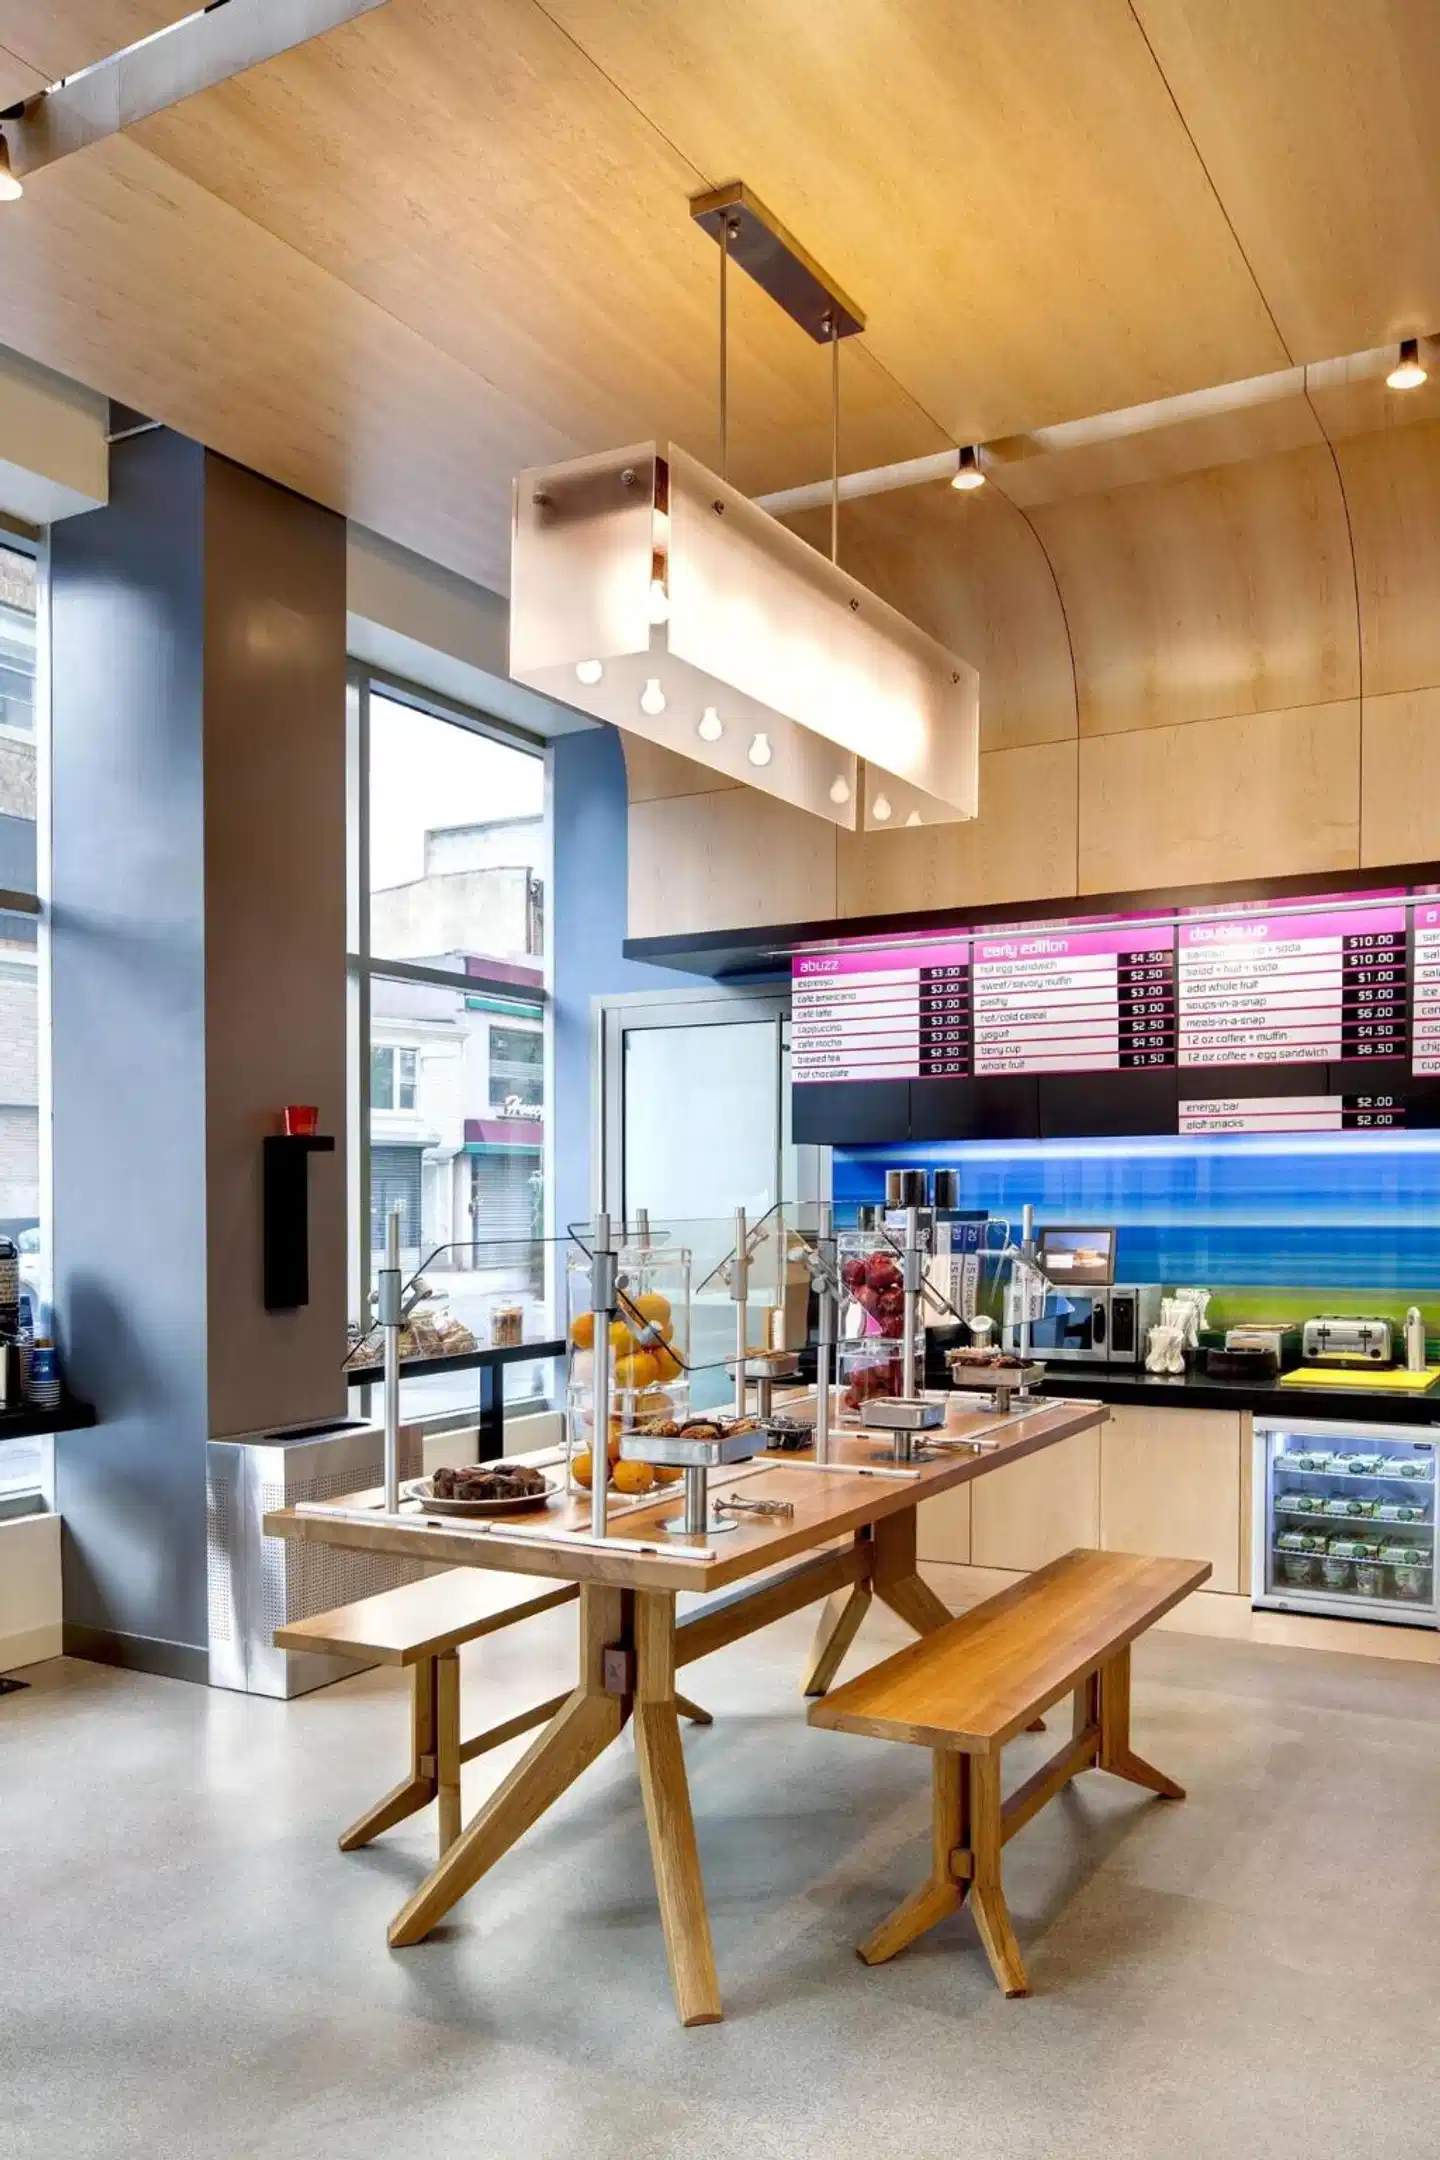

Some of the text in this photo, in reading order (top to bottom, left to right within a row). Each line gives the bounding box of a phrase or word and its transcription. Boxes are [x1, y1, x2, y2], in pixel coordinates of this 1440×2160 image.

[1020, 939, 1068, 954] edition
[800, 959, 840, 973] abuzz
[1014, 960, 1057, 972] sandwich
[1186, 983, 1206, 994] add
[1208, 981, 1238, 993] whole
[1240, 979, 1259, 990] fruit
[1020, 1011, 1047, 1021] cereal
[1186, 1015, 1266, 1028] meals-in-a-snap
[980, 1029, 1010, 1041] yogurt
[1186, 1035, 1200, 1045] 12
[1201, 1035, 1214, 1045] oz
[1216, 1033, 1246, 1044] coffee
[1256, 1031, 1288, 1042] muffin
[1005, 1045, 1021, 1056] cup
[1187, 1052, 1201, 1062] 12
[1202, 1052, 1215, 1062] oz
[1217, 1050, 1247, 1061] coffee
[1257, 1051, 1277, 1061] egg
[1279, 1047, 1329, 1060] sandwich
[980, 1060, 1007, 1070] whole
[1008, 1060, 1025, 1070] fruit
[1186, 1103, 1221, 1113] energy
[1223, 1101, 1240, 1112] bar
[1210, 1118, 1244, 1129] snacks
